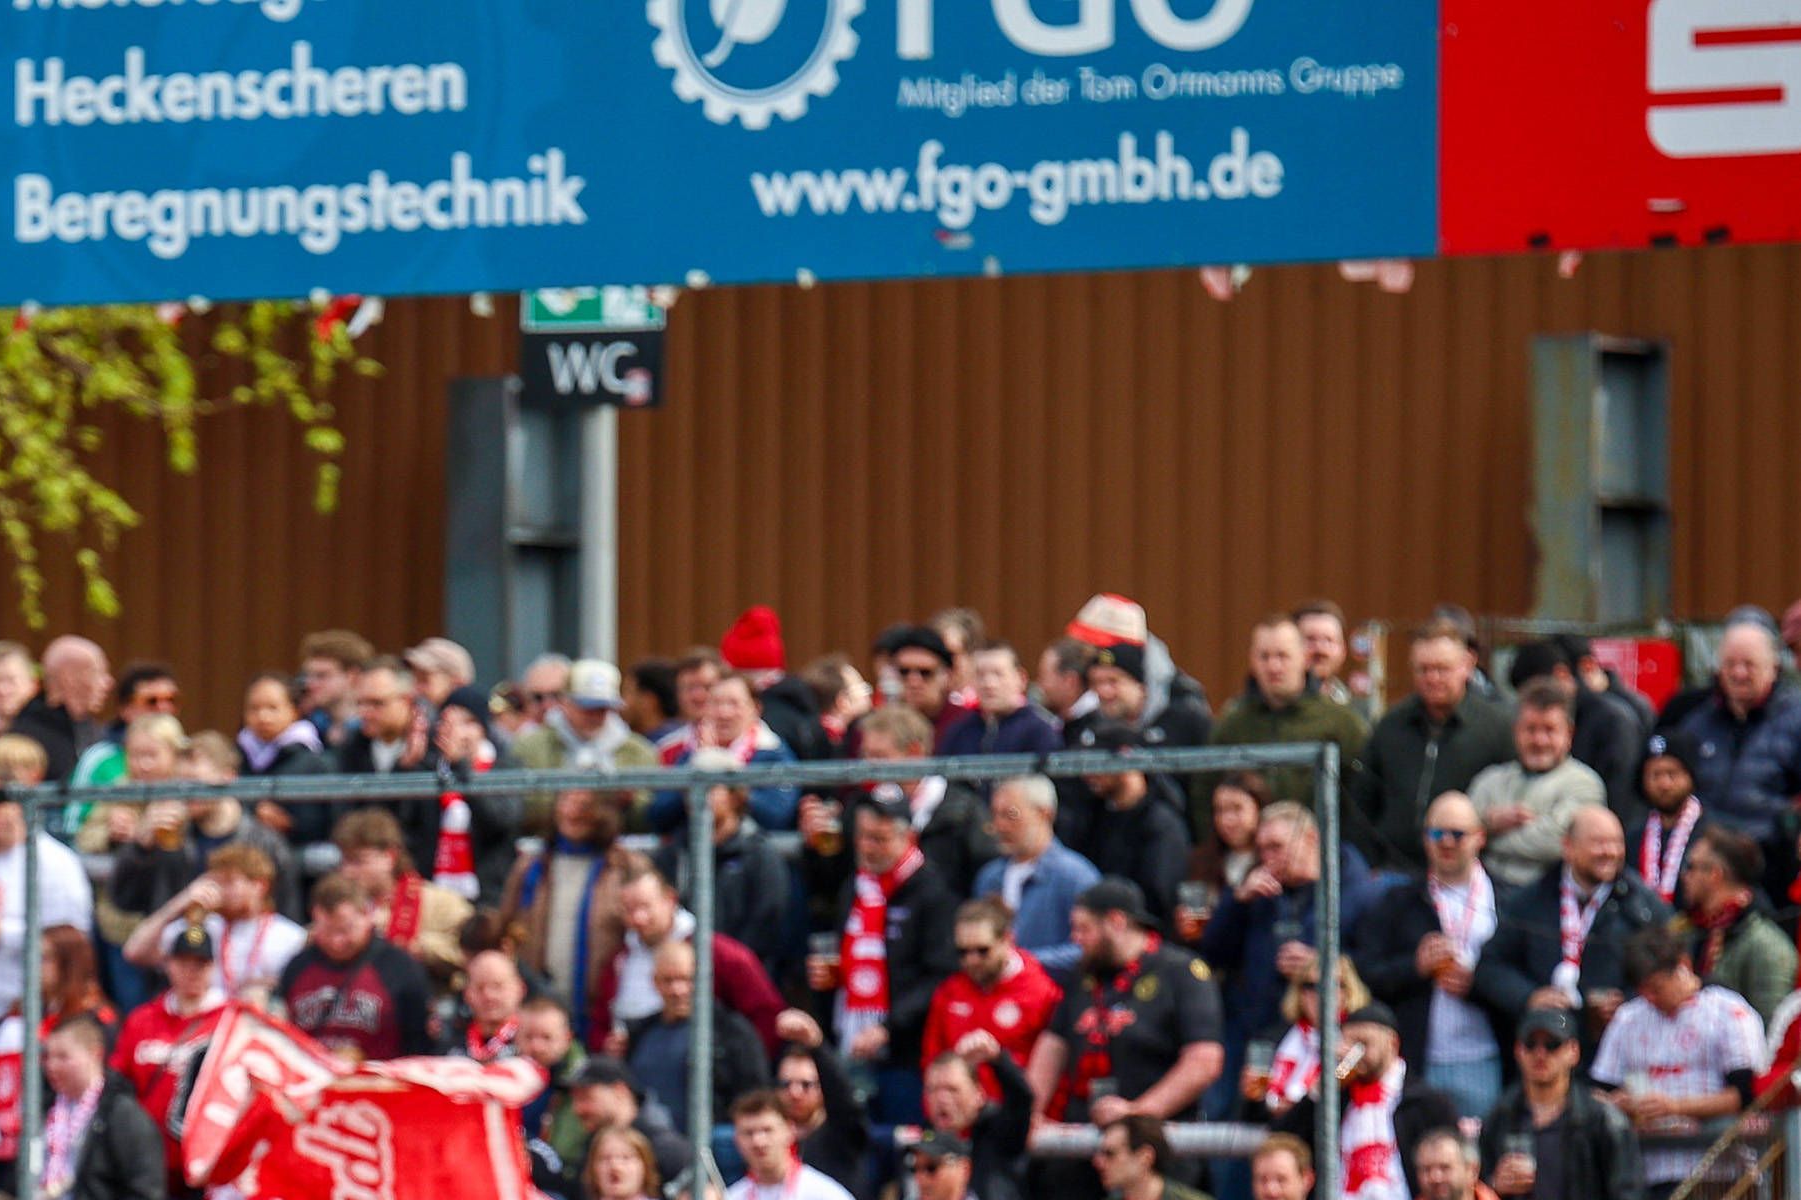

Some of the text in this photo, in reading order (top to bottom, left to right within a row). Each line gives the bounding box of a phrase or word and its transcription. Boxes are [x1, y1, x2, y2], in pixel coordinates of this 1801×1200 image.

[14, 41, 467, 126] Heckenscheren
[897, 70, 1017, 117] Mitglied
[1021, 67, 1069, 106] der
[1079, 65, 1137, 103] Tom
[1289, 57, 1405, 98] Gruppe
[14, 148, 590, 258] Beregnungstechnik
[752, 127, 1283, 227] www.fgo-gmbh.de
[546, 340, 639, 396] WC
